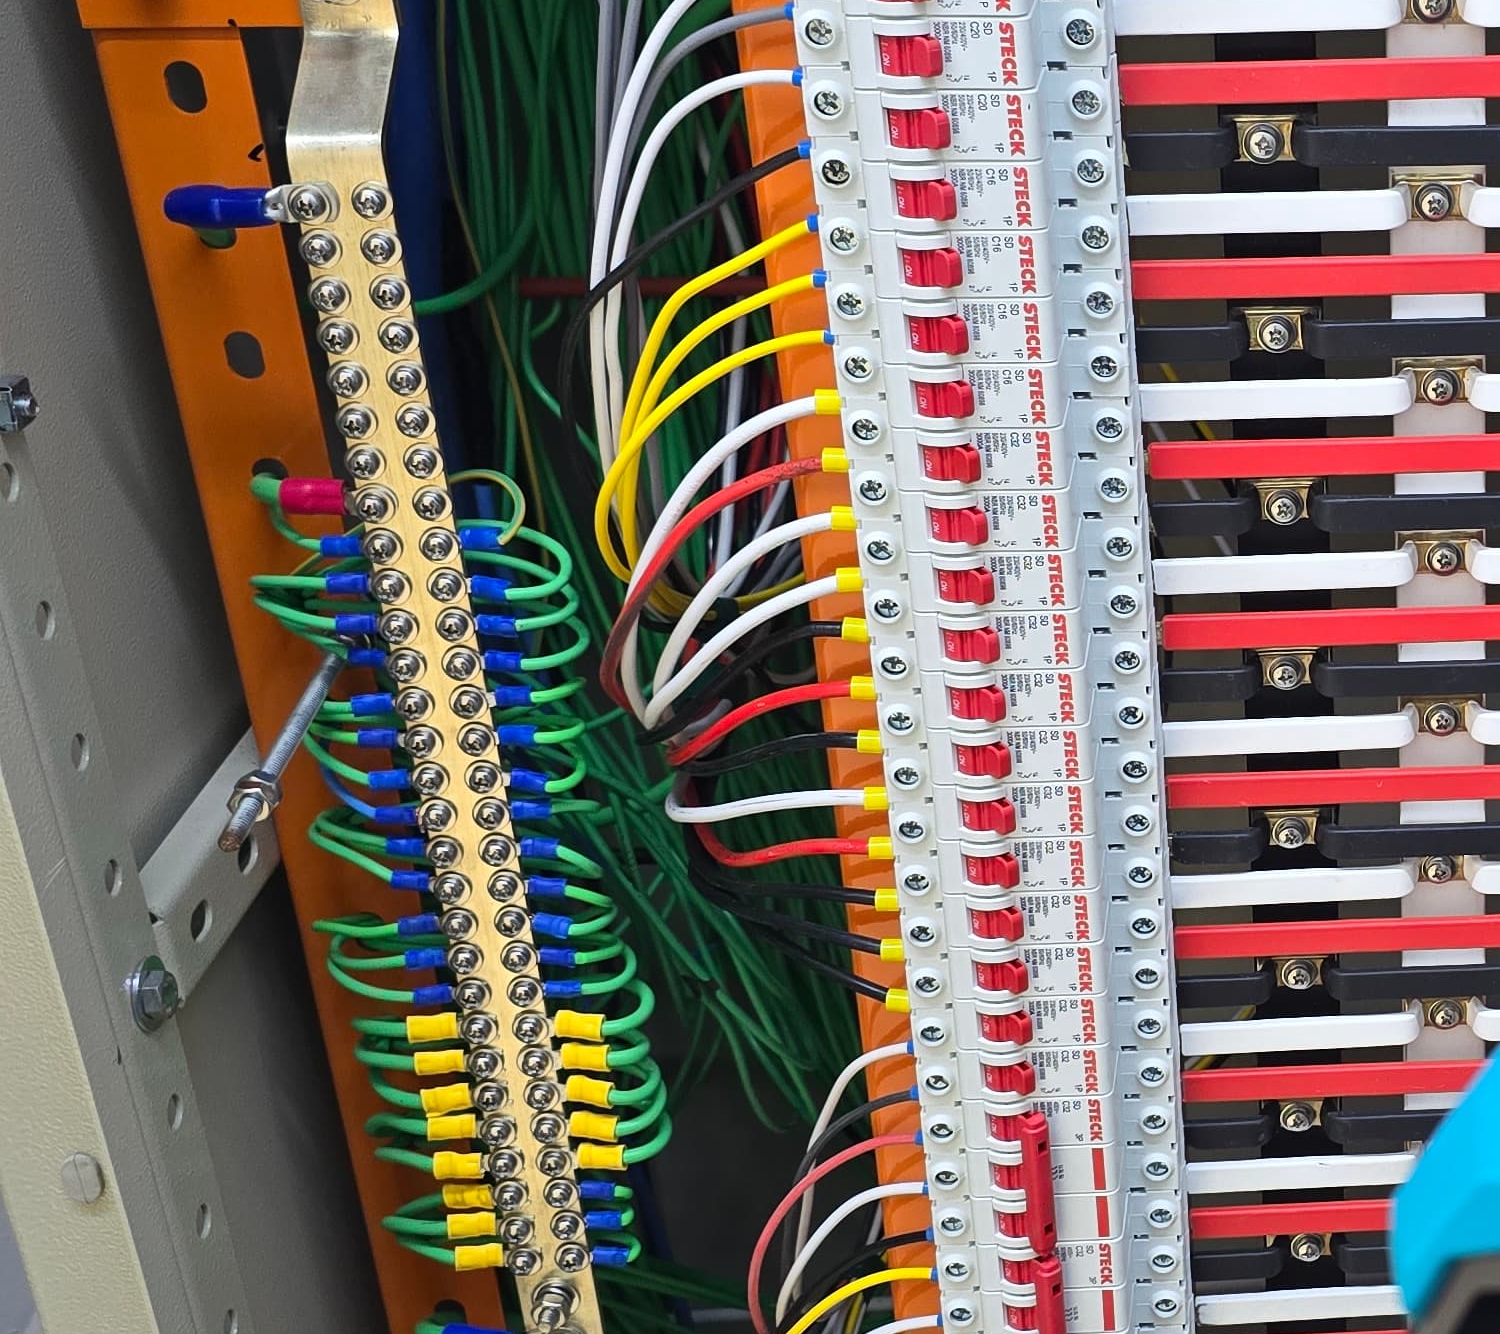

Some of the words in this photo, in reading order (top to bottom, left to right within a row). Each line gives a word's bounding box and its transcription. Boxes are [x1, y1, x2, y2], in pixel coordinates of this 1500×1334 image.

[998, 22, 1017, 85] STECK
[1006, 95, 1024, 155] STECK
[1013, 167, 1031, 226] STECK
[1018, 236, 1035, 293] STECK
[1023, 303, 1041, 359] STECK
[1028, 369, 1046, 424] STECK
[1035, 431, 1053, 485] STECK
[1041, 494, 1058, 548] STECK
[1047, 554, 1064, 606] STECK
[1051, 614, 1069, 664] STECK
[1057, 673, 1074, 723] STECK
[1063, 731, 1079, 779] STECK
[1067, 785, 1083, 834] STECK
[1069, 840, 1085, 886] STECK
[1073, 895, 1089, 941] STECK
[1077, 947, 1092, 992] STECK
[1080, 998, 1096, 1043] STECK
[1083, 1050, 1098, 1093] STECK
[1088, 1099, 1102, 1142] STECK
[1098, 1243, 1113, 1286] STECK
